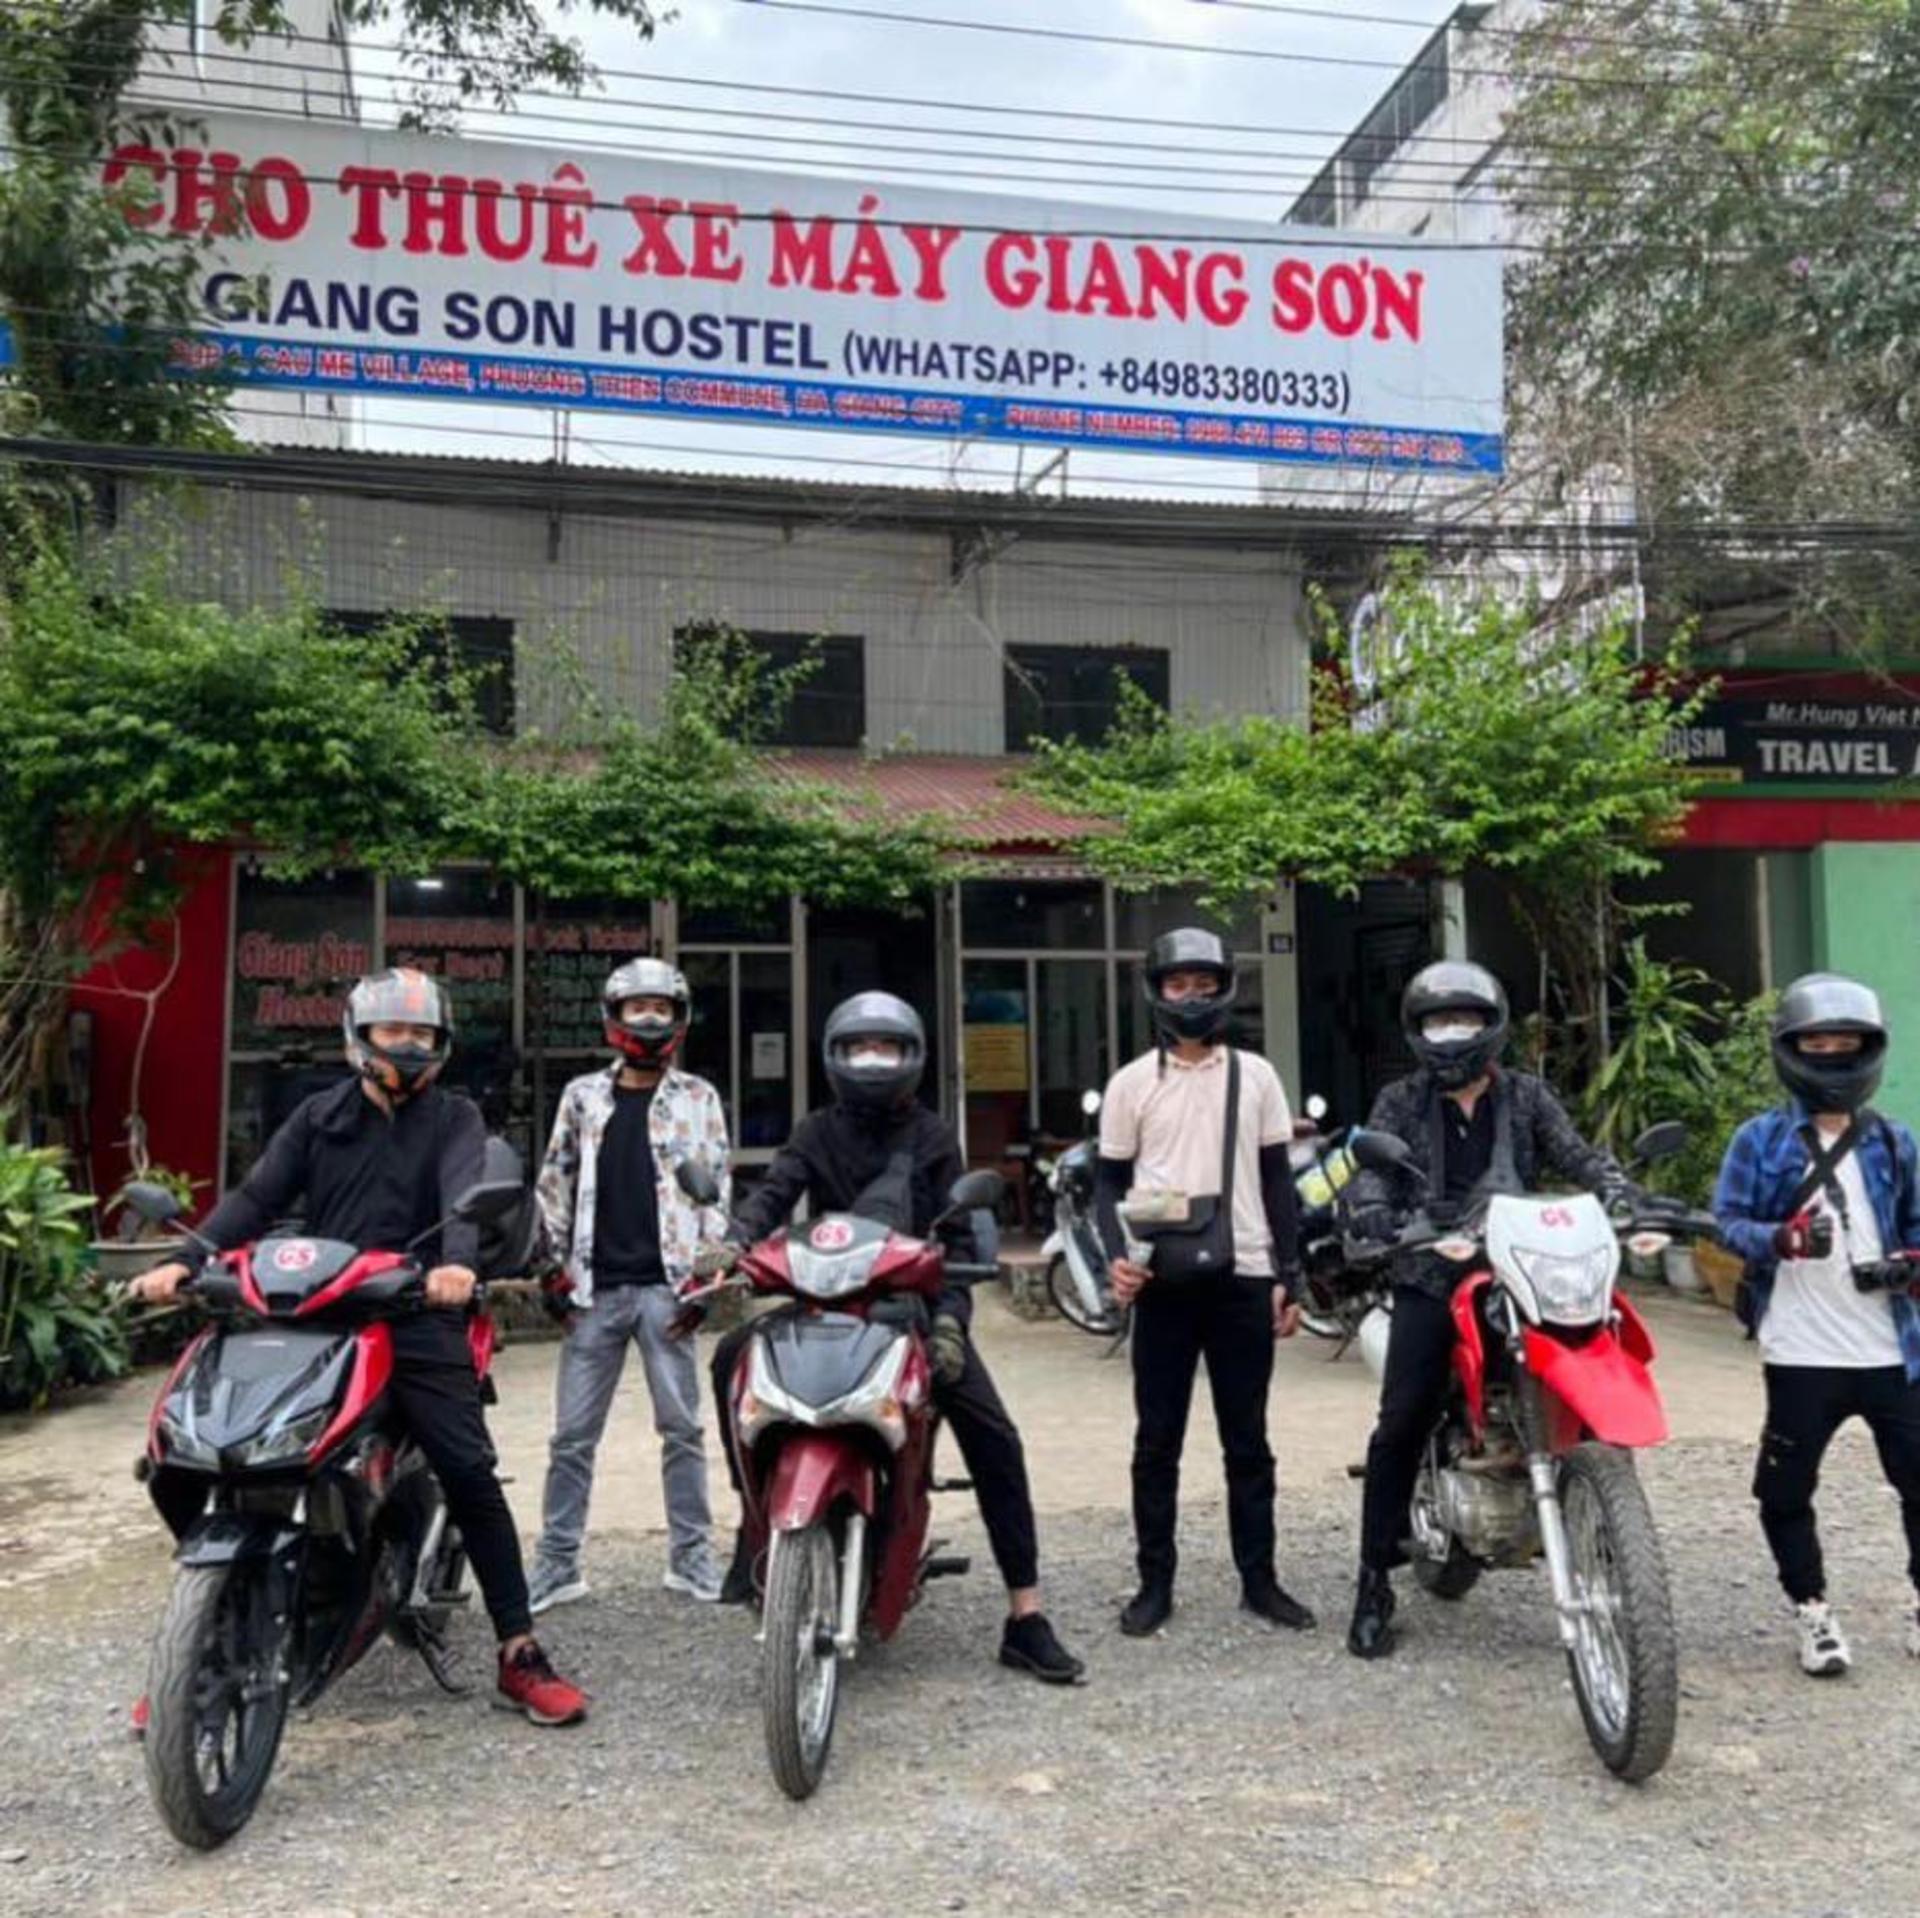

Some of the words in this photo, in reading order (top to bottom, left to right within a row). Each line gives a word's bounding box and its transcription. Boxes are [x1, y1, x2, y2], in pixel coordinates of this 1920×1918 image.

[103, 143, 311, 241] CHO
[339, 162, 598, 267] THUÊ
[623, 192, 745, 284] XE
[768, 195, 962, 302] MÁY
[984, 229, 1250, 328] GIANG
[1271, 256, 1425, 343] SƠN
[204, 272, 420, 336] GIANG
[444, 295, 575, 350] SON
[600, 307, 829, 370] HOSTEL
[842, 329, 1087, 391] (WHATSAPP:
[1098, 360, 1351, 414] +84983380333)
[358, 351, 474, 392] VILLAGE,
[1864, 703, 1907, 726] Viet
[1756, 738, 1898, 775] TRAVEL
